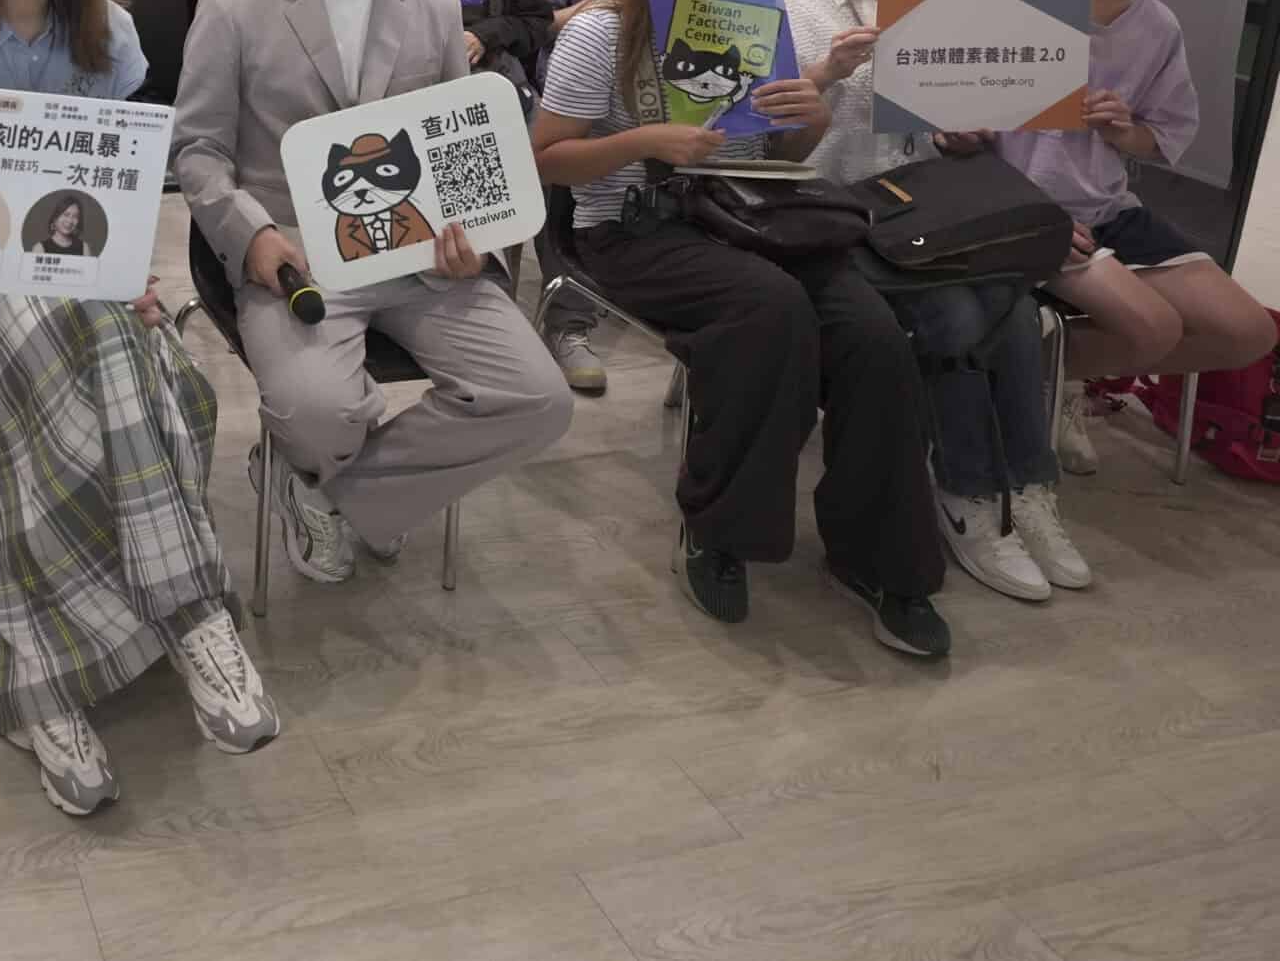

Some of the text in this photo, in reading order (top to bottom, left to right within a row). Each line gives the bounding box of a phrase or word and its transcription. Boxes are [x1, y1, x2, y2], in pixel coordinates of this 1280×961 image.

[690, 0, 742, 18] Taiwan
[687, 14, 761, 37] FactCheck
[684, 29, 733, 46] Center
[421, 102, 490, 140] 查小喵
